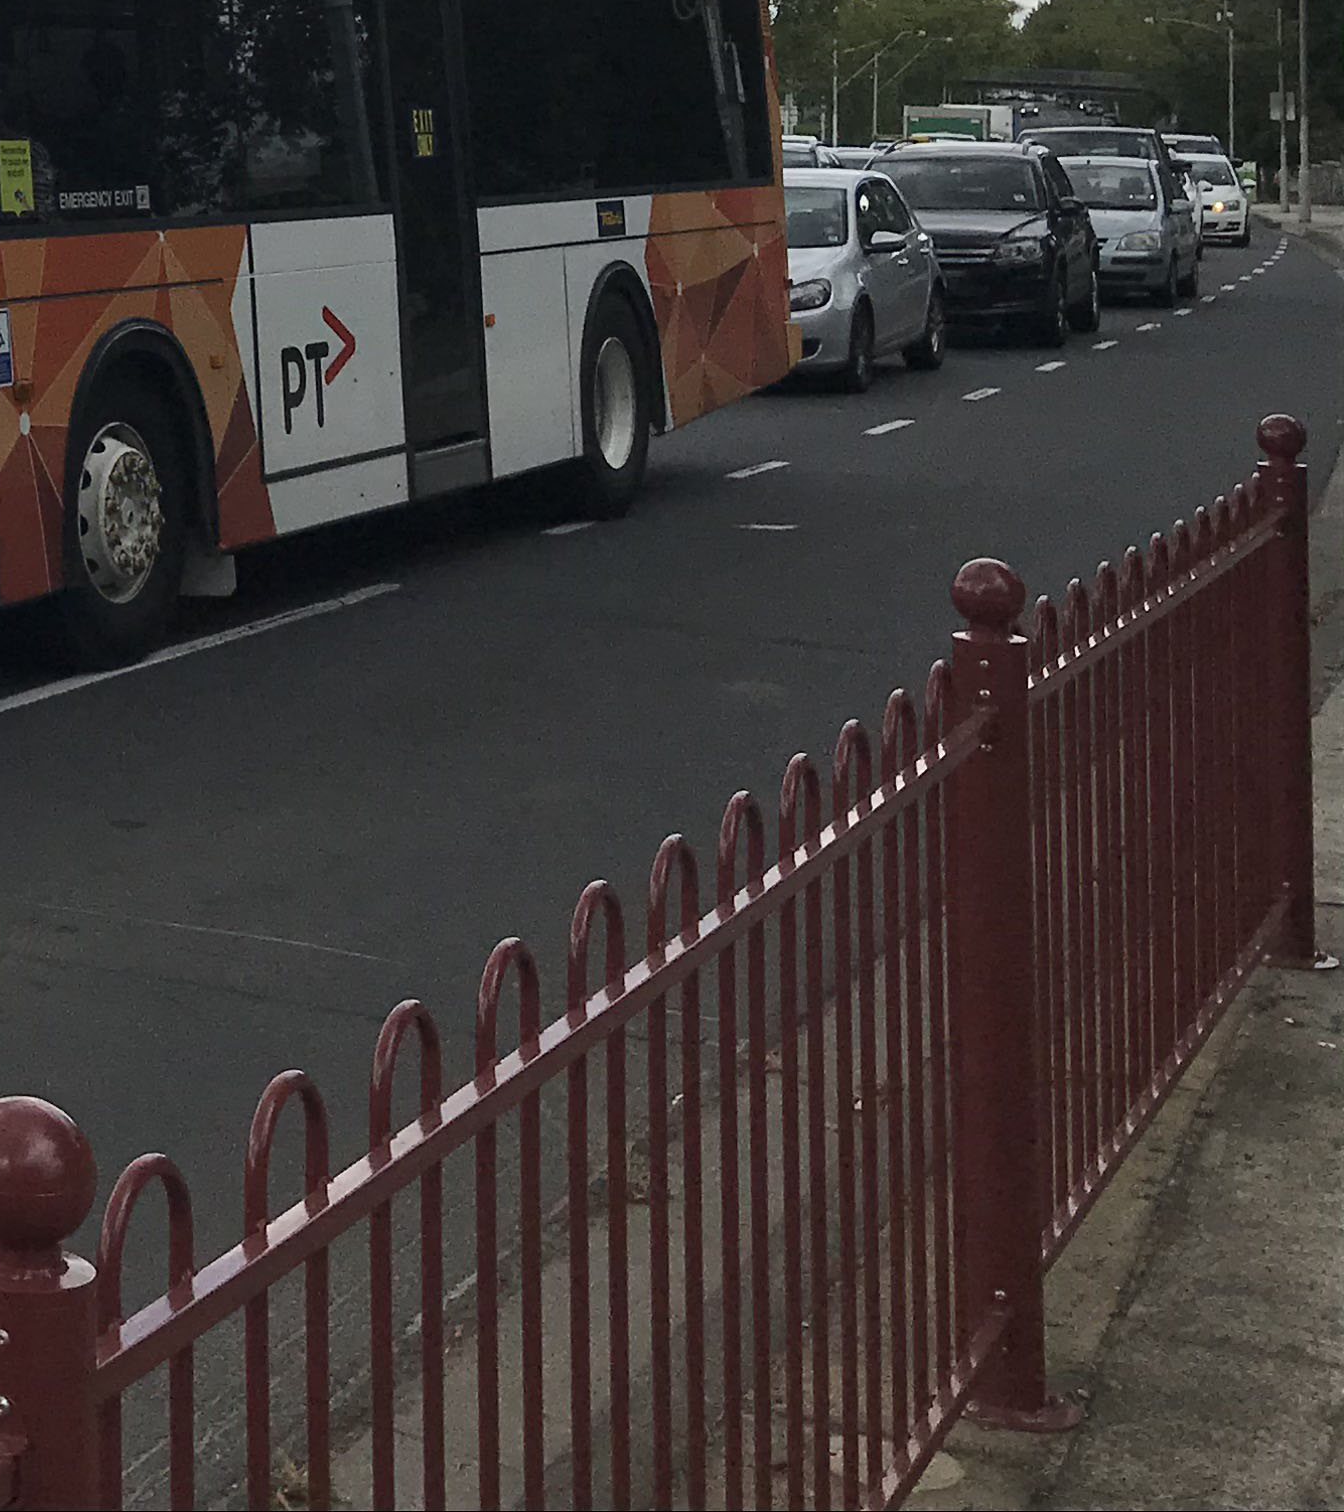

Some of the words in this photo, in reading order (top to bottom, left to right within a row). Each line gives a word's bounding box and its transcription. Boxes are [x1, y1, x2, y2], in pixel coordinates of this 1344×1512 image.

[59, 191, 112, 209] EMERGENCY
[115, 190, 134, 207] EXIT
[280, 341, 330, 436] PT
